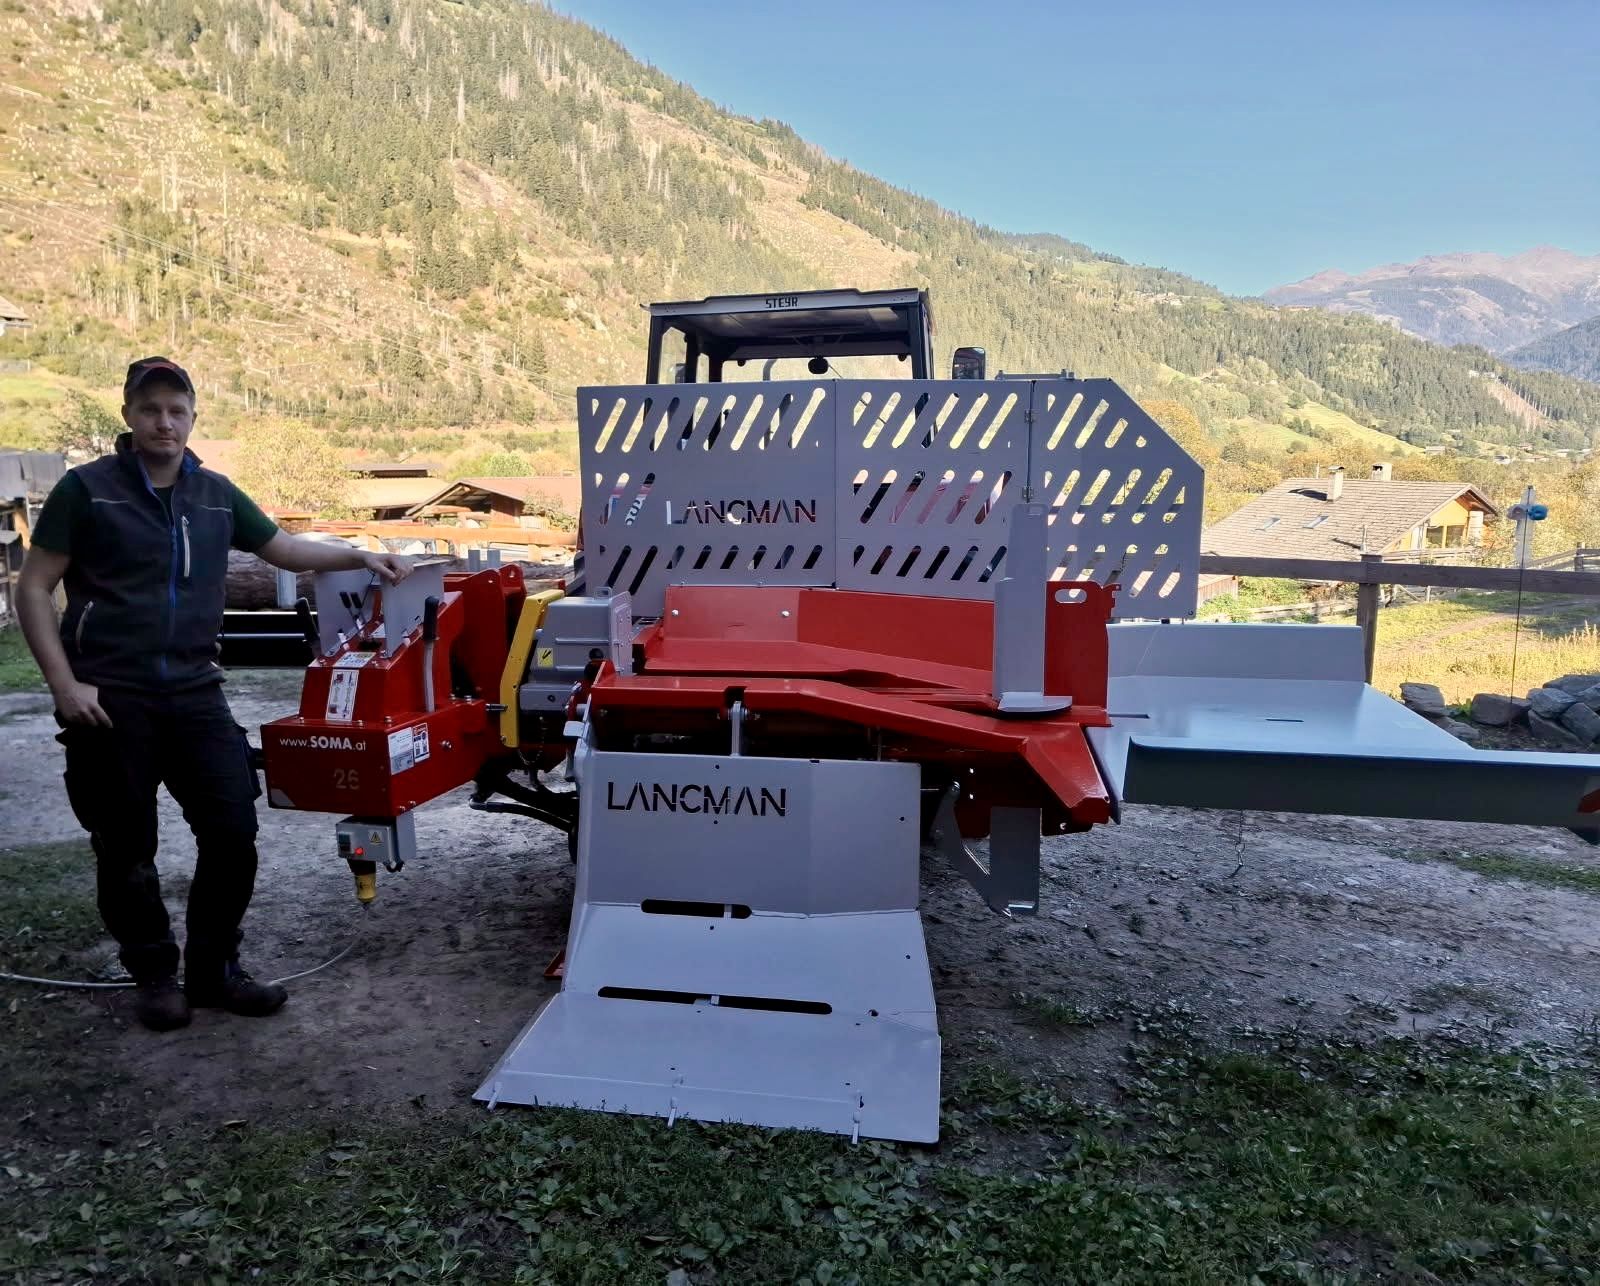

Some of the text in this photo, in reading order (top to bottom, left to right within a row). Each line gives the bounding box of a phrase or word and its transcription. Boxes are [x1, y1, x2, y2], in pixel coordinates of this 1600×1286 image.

[665, 500, 817, 525] LANCMAN
[279, 736, 367, 751] www.SOMA.at
[608, 782, 786, 817] LANCMAN
